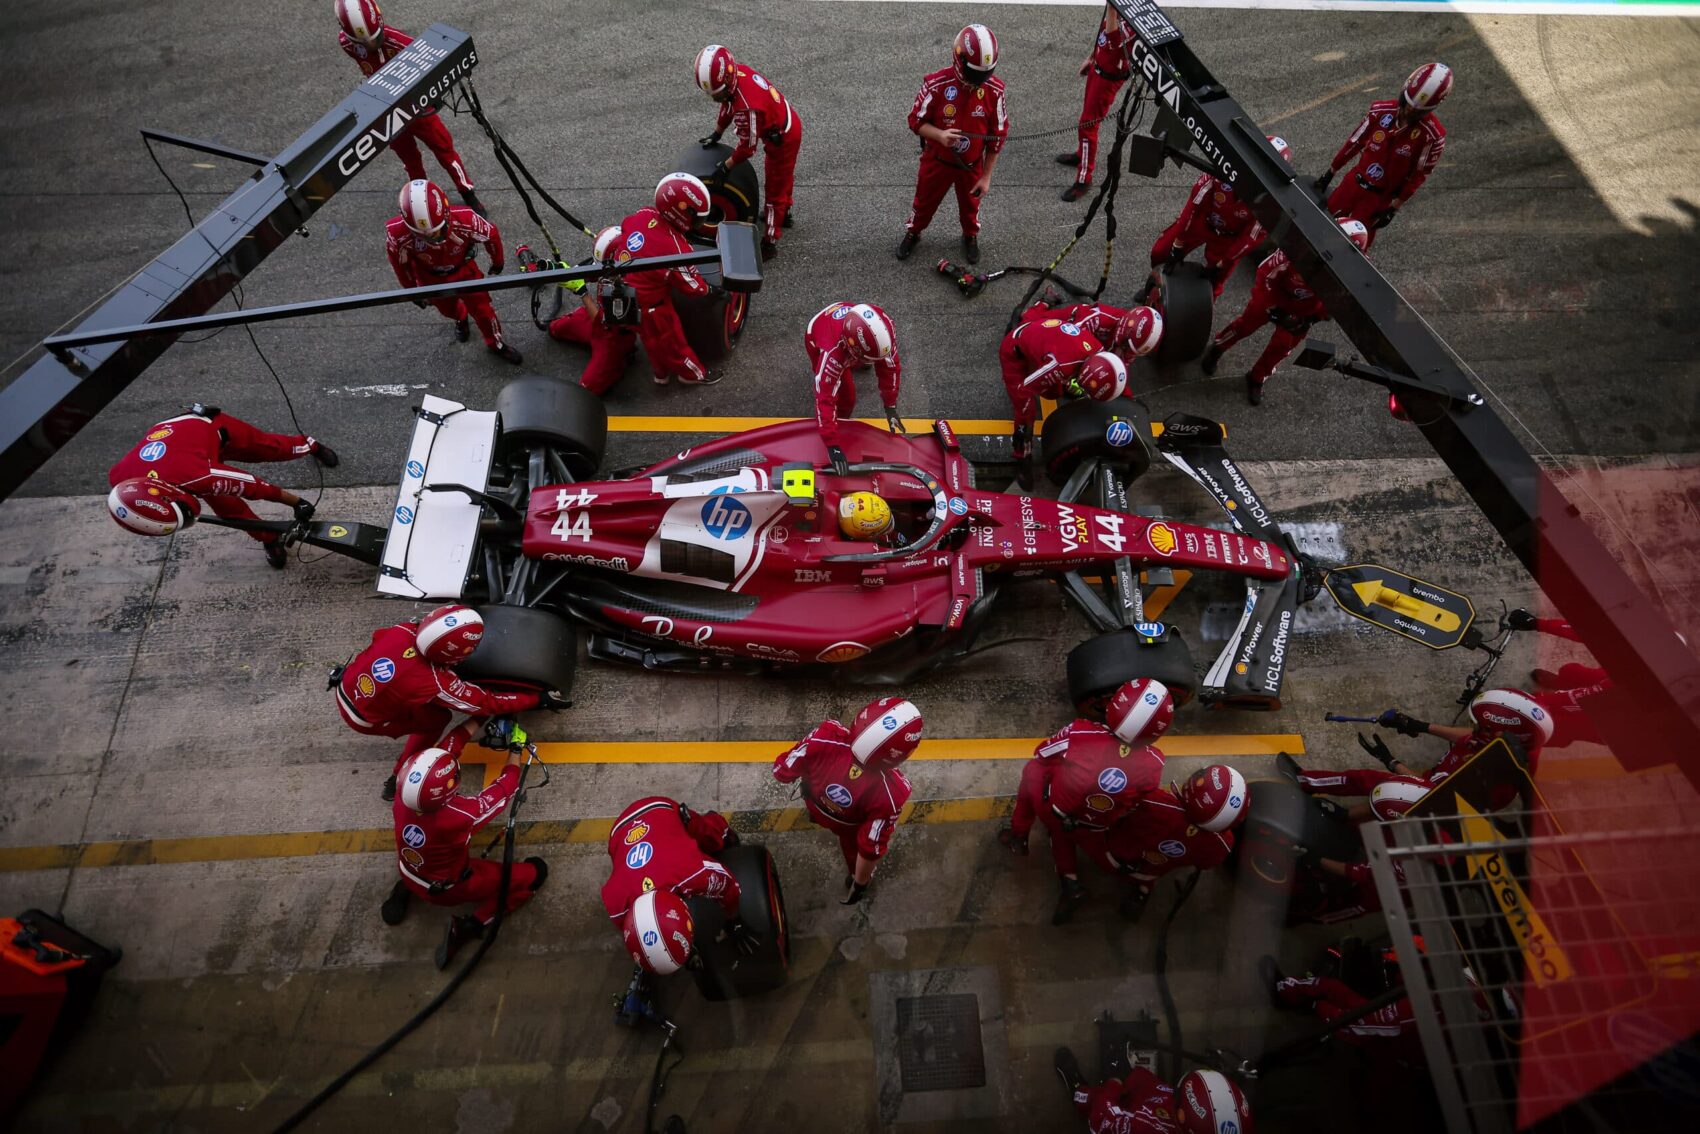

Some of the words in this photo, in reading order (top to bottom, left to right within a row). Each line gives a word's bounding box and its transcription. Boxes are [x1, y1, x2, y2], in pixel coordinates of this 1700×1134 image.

[367, 38, 448, 97] IBM
[412, 51, 476, 115] LOGISTICS
[945, 86, 957, 100] hp
[1183, 117, 1238, 182] OGISTICS
[1366, 163, 1384, 180] hp
[627, 232, 644, 251] hp
[939, 420, 951, 435] VGW
[1107, 422, 1132, 446] hp
[1170, 423, 1201, 433] aws
[141, 442, 166, 461] hp
[407, 461, 424, 478] hp
[1198, 467, 1229, 501] V-Power
[1221, 458, 1272, 528] HCLSoftware
[396, 506, 413, 524] hp
[950, 498, 967, 515] hp
[551, 511, 593, 542] 44
[704, 495, 751, 541] hp
[981, 499, 994, 547] PEONI
[1020, 496, 1036, 545] GENESYS
[1057, 503, 1079, 553] VGW
[1075, 515, 1089, 543] PLAY
[1094, 514, 1127, 552] 44
[1185, 532, 1195, 552] aws
[1203, 533, 1217, 559] IBM
[794, 568, 832, 582] IBM
[864, 576, 884, 584] aws
[1412, 586, 1445, 603] brembo
[954, 599, 964, 617] VGW
[1394, 618, 1426, 635] brembo
[1240, 621, 1263, 663] V-Power
[1264, 610, 1291, 692] HCLSoftware
[372, 658, 395, 682] hp
[883, 716, 897, 730] hp
[1489, 714, 1521, 726] UniCredit
[409, 771, 421, 784] hp
[1099, 769, 1127, 793] hp
[826, 784, 852, 807] hp
[403, 825, 425, 847] hp
[628, 842, 651, 868] hp
[1159, 841, 1185, 857] hp
[1484, 853, 1559, 982] brembo
[644, 931, 657, 946] hp
